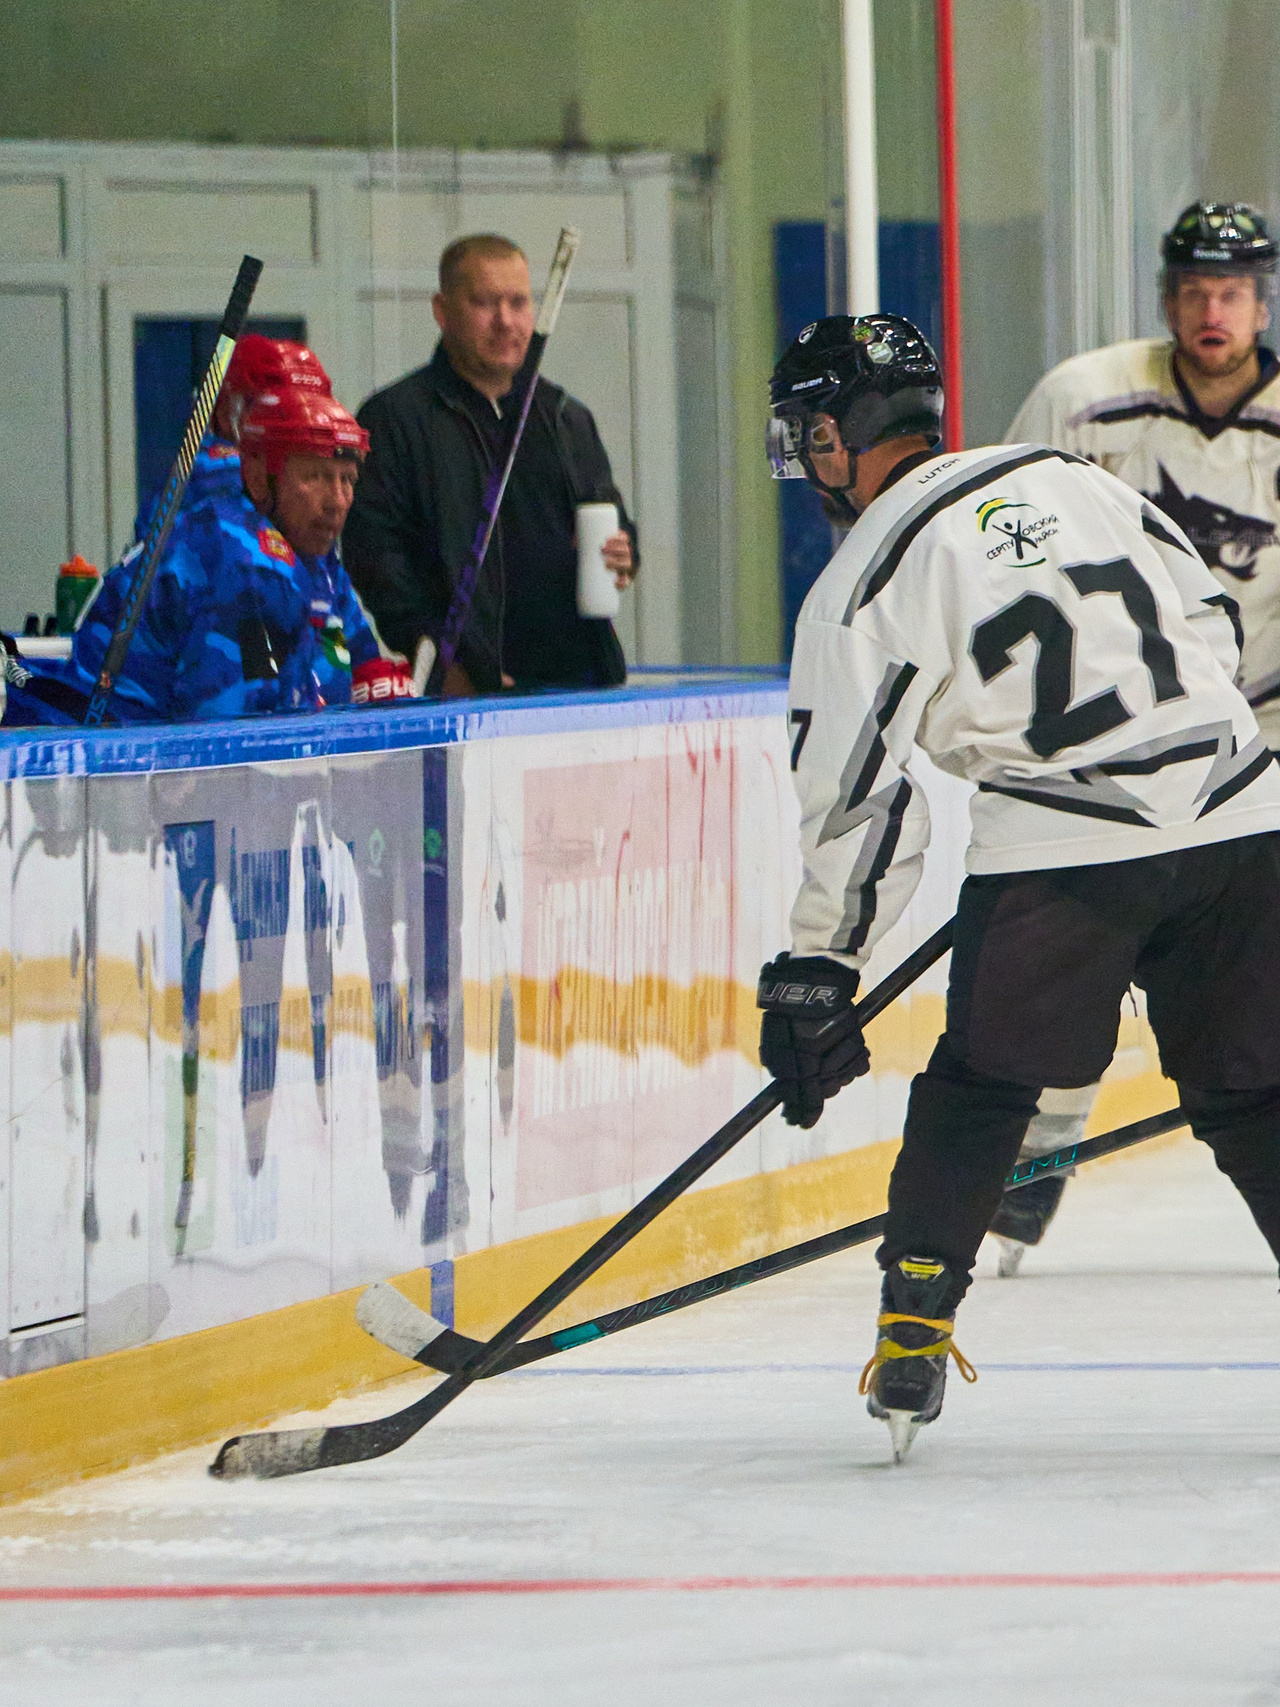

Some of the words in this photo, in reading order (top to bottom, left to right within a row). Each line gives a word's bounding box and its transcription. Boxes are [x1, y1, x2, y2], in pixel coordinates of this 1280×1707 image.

[918, 458, 960, 484] LUTCH
[968, 556, 1188, 758] 27
[351, 677, 417, 704] BAU
[787, 708, 813, 772] 7
[759, 982, 838, 1007] UER
